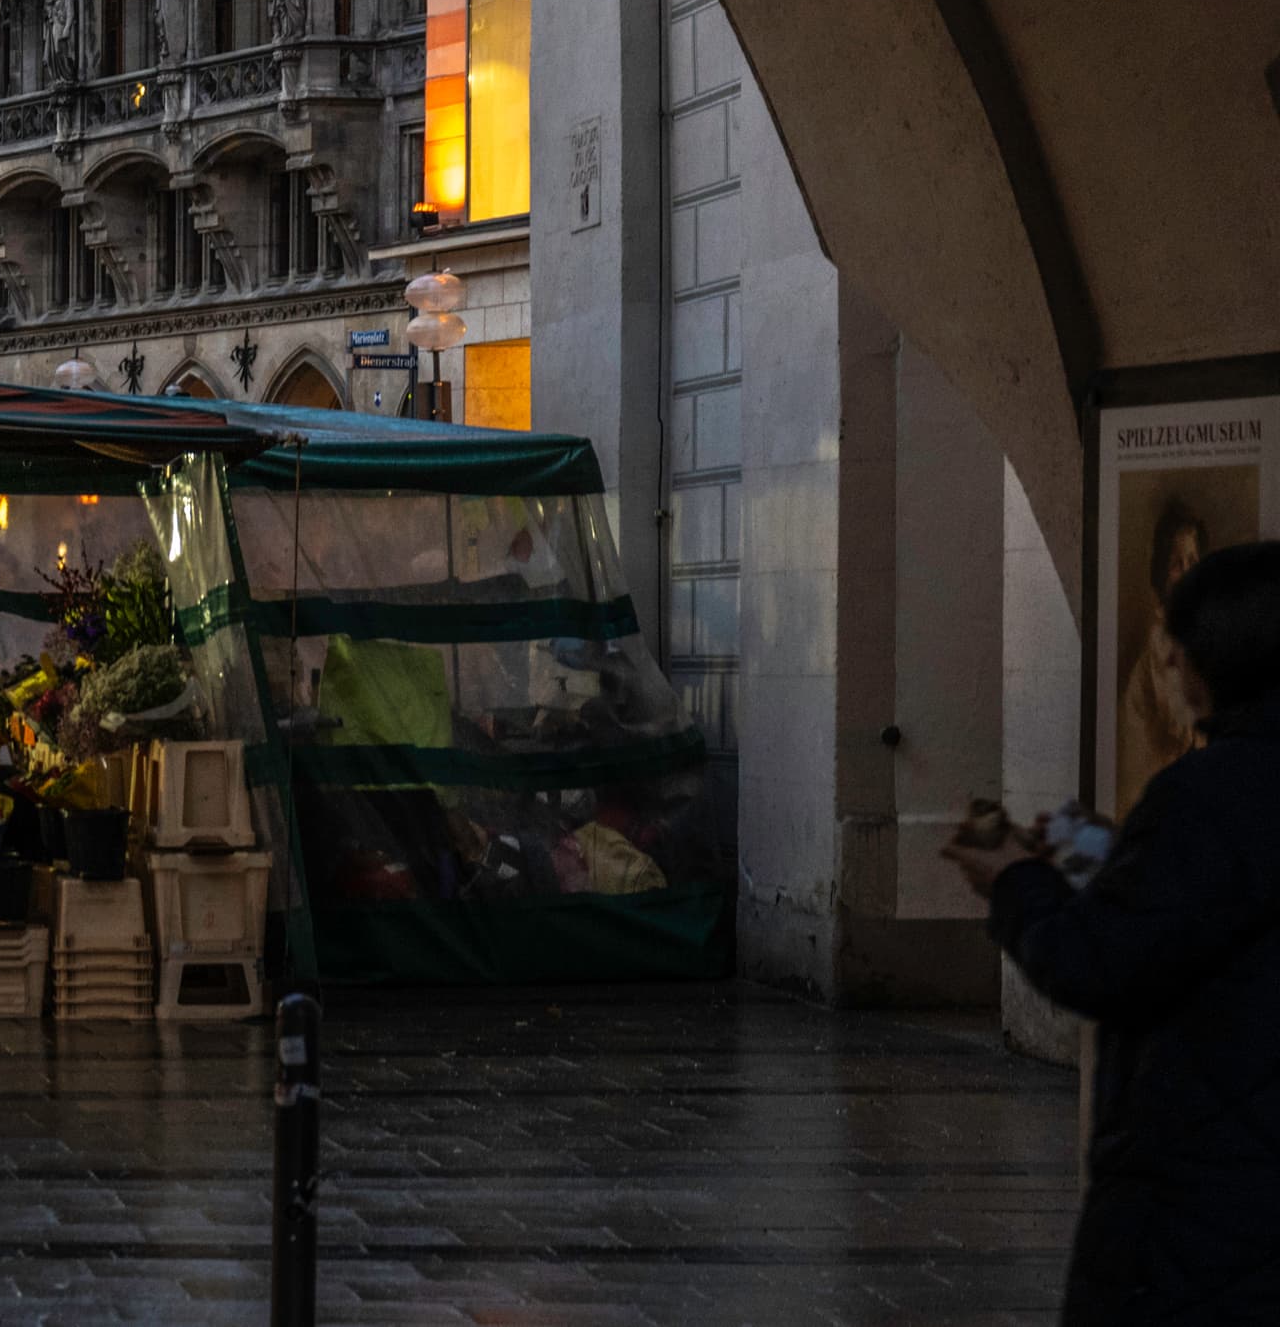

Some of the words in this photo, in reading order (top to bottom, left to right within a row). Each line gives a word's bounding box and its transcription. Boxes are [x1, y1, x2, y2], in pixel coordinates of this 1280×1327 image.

[352, 330, 386, 345] Marienplatz
[360, 355, 417, 369] Dienerstraß
[1117, 419, 1262, 450] SPIELZEUGMUSEUM
